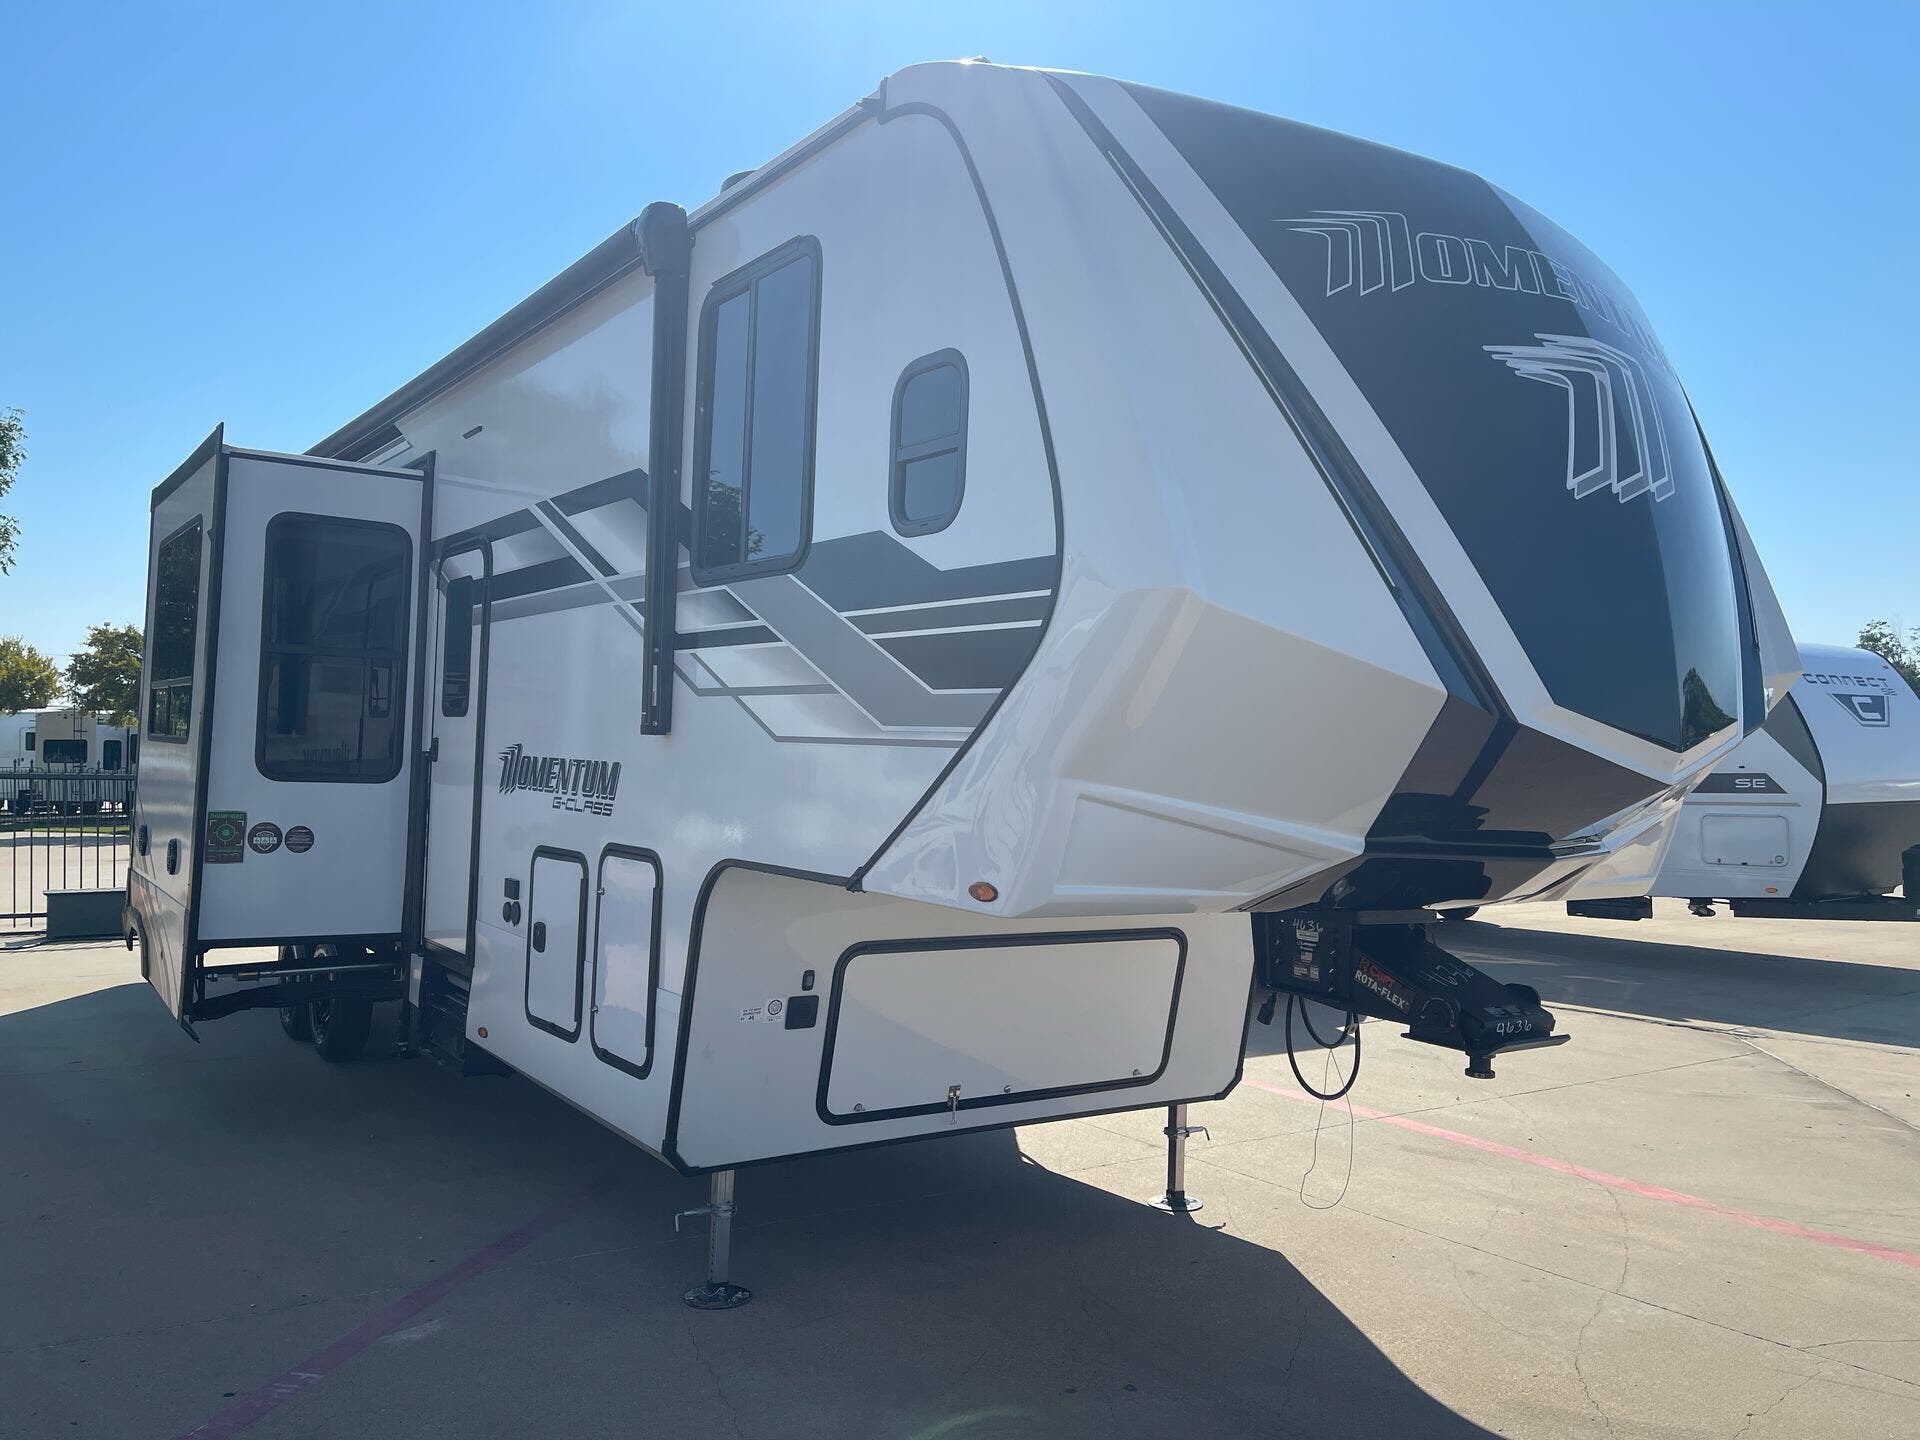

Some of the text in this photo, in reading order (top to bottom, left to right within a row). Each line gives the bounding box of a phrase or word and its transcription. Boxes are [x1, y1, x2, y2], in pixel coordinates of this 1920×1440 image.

[1802, 673, 1889, 688] CONNECT
[498, 743, 622, 801] MOMENTUM
[1735, 778, 1767, 789] SE
[552, 796, 614, 817] G-CLASS
[1354, 970, 1407, 1010] ROTA-FLEX
[1496, 1019, 1532, 1037] 4636
